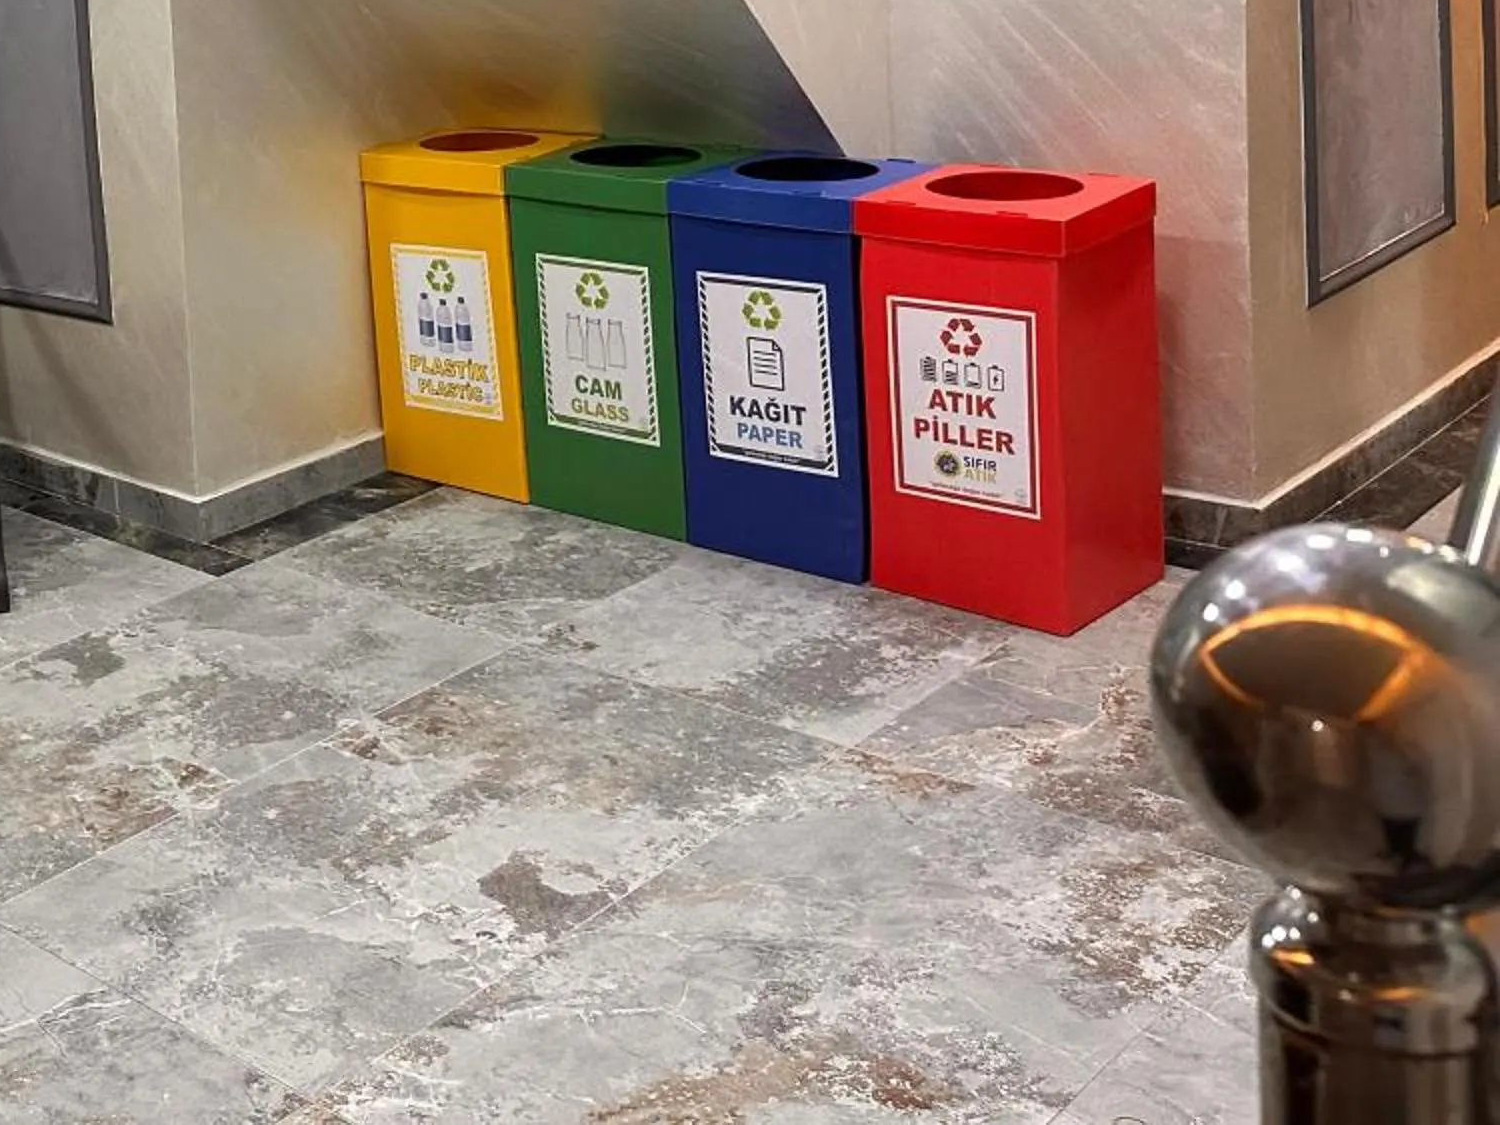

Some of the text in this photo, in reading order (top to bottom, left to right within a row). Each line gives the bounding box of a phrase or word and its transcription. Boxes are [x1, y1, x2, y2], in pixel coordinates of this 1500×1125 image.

[575, 375, 622, 401] CAM
[571, 398, 630, 422] GLASS
[729, 395, 806, 426] KAĞIT
[928, 388, 996, 419] ATIK
[737, 423, 803, 448] PAPER
[914, 415, 1015, 455] PİLLER
[963, 456, 998, 472] SIFIR
